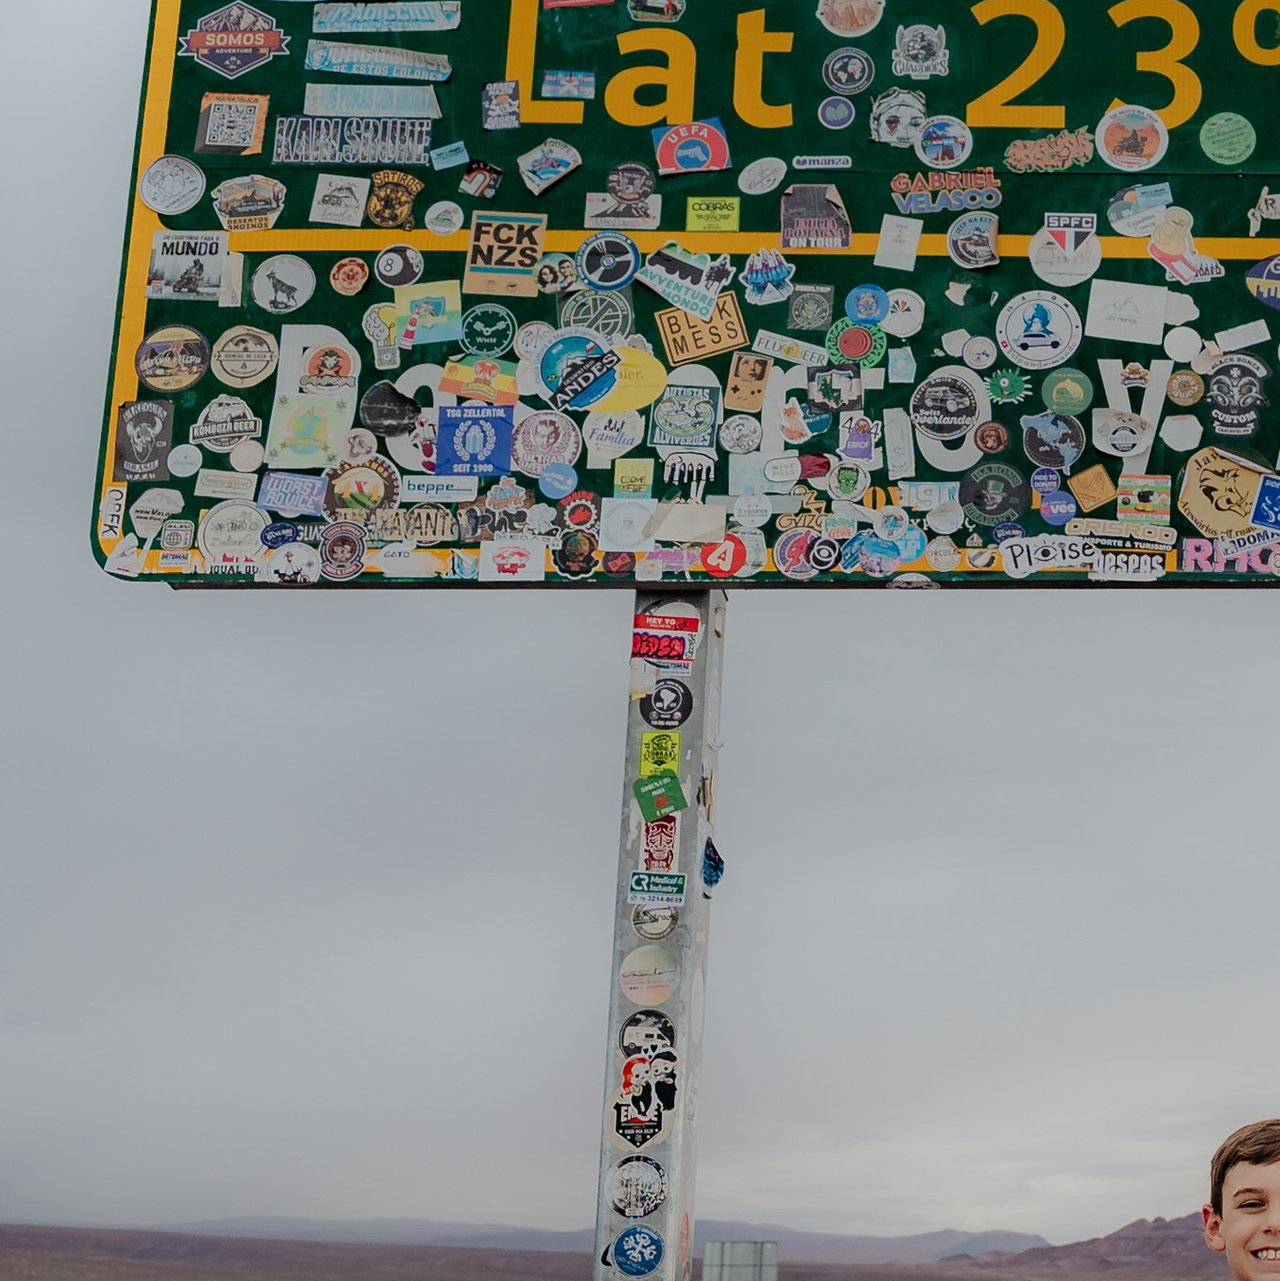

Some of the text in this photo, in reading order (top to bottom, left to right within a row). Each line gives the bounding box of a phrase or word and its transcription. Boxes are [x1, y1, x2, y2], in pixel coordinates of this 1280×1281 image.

[205, 33, 265, 45] SOMOS
[352, 66, 443, 82] ESTOS COLORES
[273, 118, 430, 162] KARLSRUHE
[667, 125, 709, 144] UEFA
[808, 157, 850, 167] manza
[373, 170, 424, 197] SATIROS
[892, 167, 1000, 192] GABRIEL
[692, 201, 735, 211] COBRAS
[893, 187, 1002, 214] VELASCO
[1048, 217, 1093, 227] SPFC
[473, 222, 539, 246] FCK
[161, 241, 219, 256] MUNDO
[790, 238, 842, 248] ON TOUR
[470, 246, 538, 268] NZS
[383, 259, 394, 272] 8
[640, 269, 714, 308] AVVENTURE
[661, 288, 710, 317] MONDO
[671, 321, 739, 356] MESS
[556, 354, 618, 406] ANDES
[664, 386, 710, 397] AUTISTAS
[446, 408, 506, 418] TSG ZELLERTAL
[912, 415, 978, 425] Overlander
[919, 409, 940, 417] Swiss
[1212, 408, 1258, 424] CUSTOM
[654, 432, 710, 446] ALVIVERDES
[453, 464, 493, 473] SEIT 1900
[974, 464, 1021, 486] BARONS
[268, 477, 322, 496] WORST
[407, 480, 454, 493] beppe
[266, 491, 318, 508] ADVICE
[1067, 519, 1174, 543] CRISROD
[1134, 542, 1172, 551] TURISMO
[632, 874, 677, 891] CR Medical
[650, 883, 678, 894] Industry
